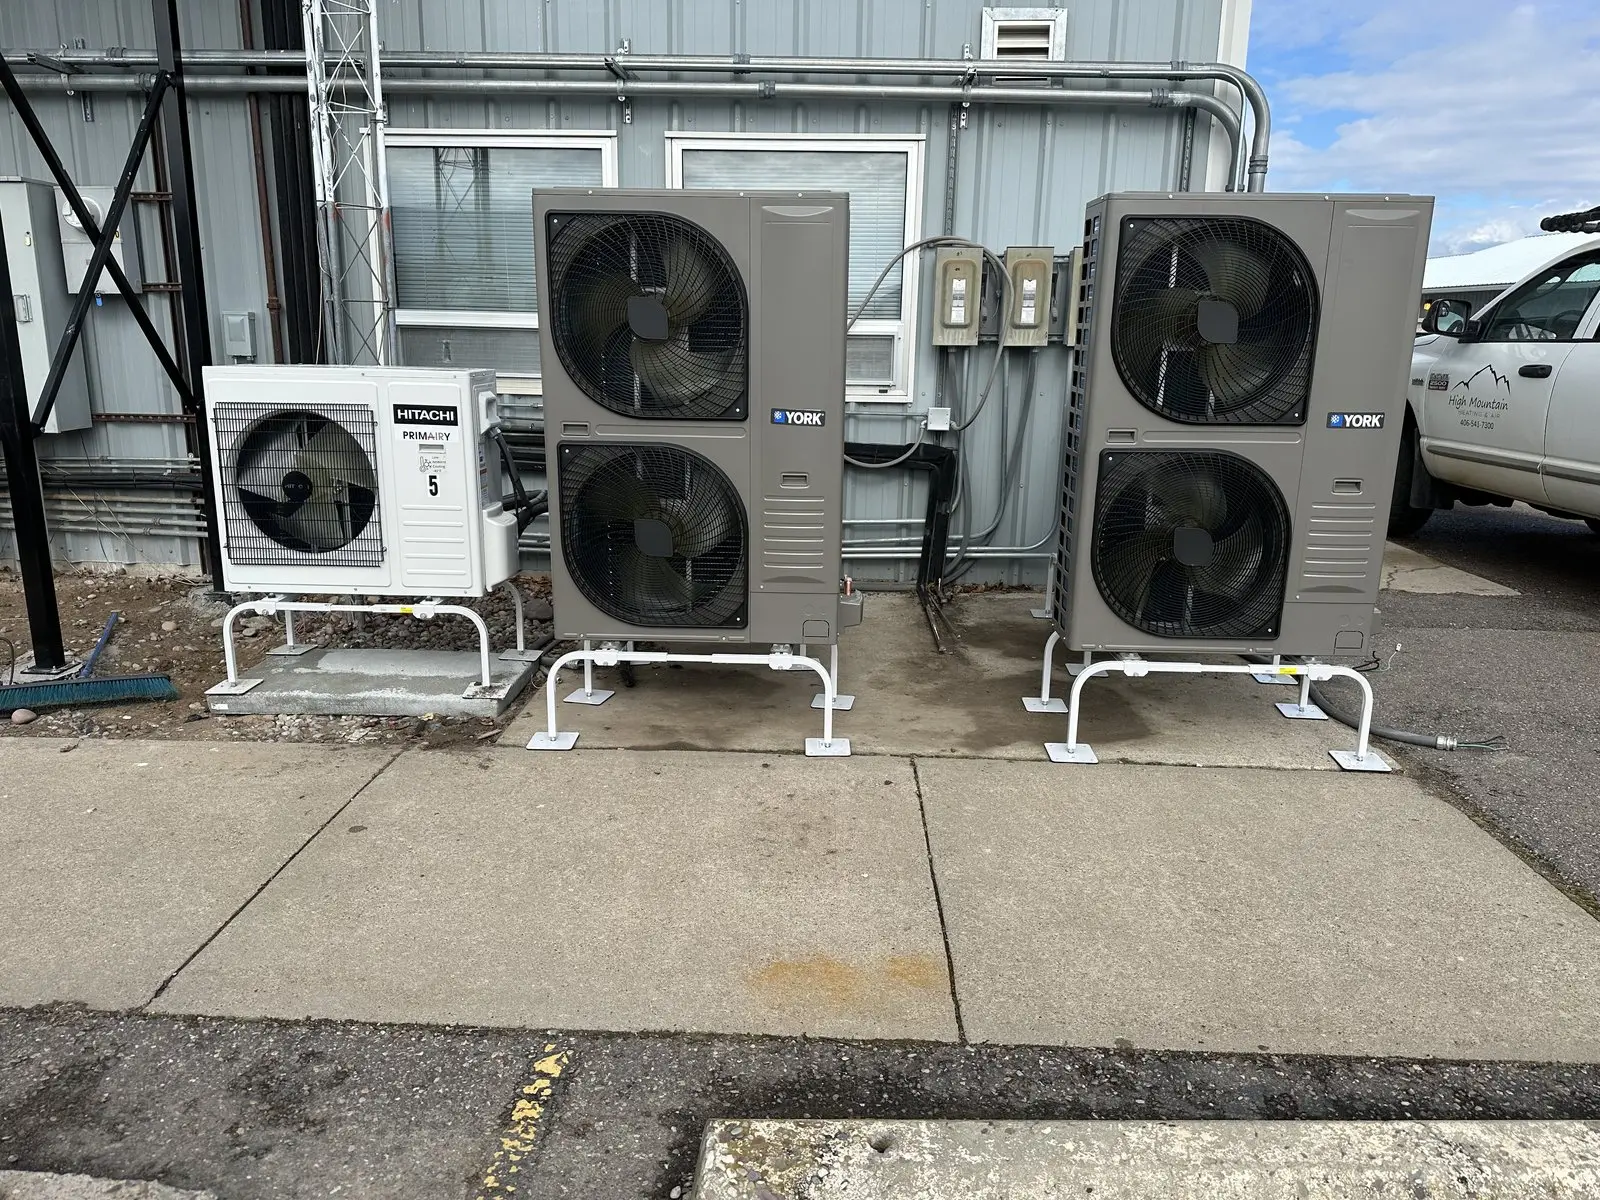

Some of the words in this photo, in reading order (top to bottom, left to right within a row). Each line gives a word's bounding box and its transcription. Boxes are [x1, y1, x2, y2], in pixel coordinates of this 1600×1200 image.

[1448, 395, 1467, 410] High
[1469, 397, 1509, 411] Mountain
[397, 409, 454, 421] HITACHI
[785, 411, 822, 425] YORK
[1344, 414, 1382, 428] YORK
[402, 431, 451, 441] PRIMAIRY
[428, 475, 439, 496] 5
